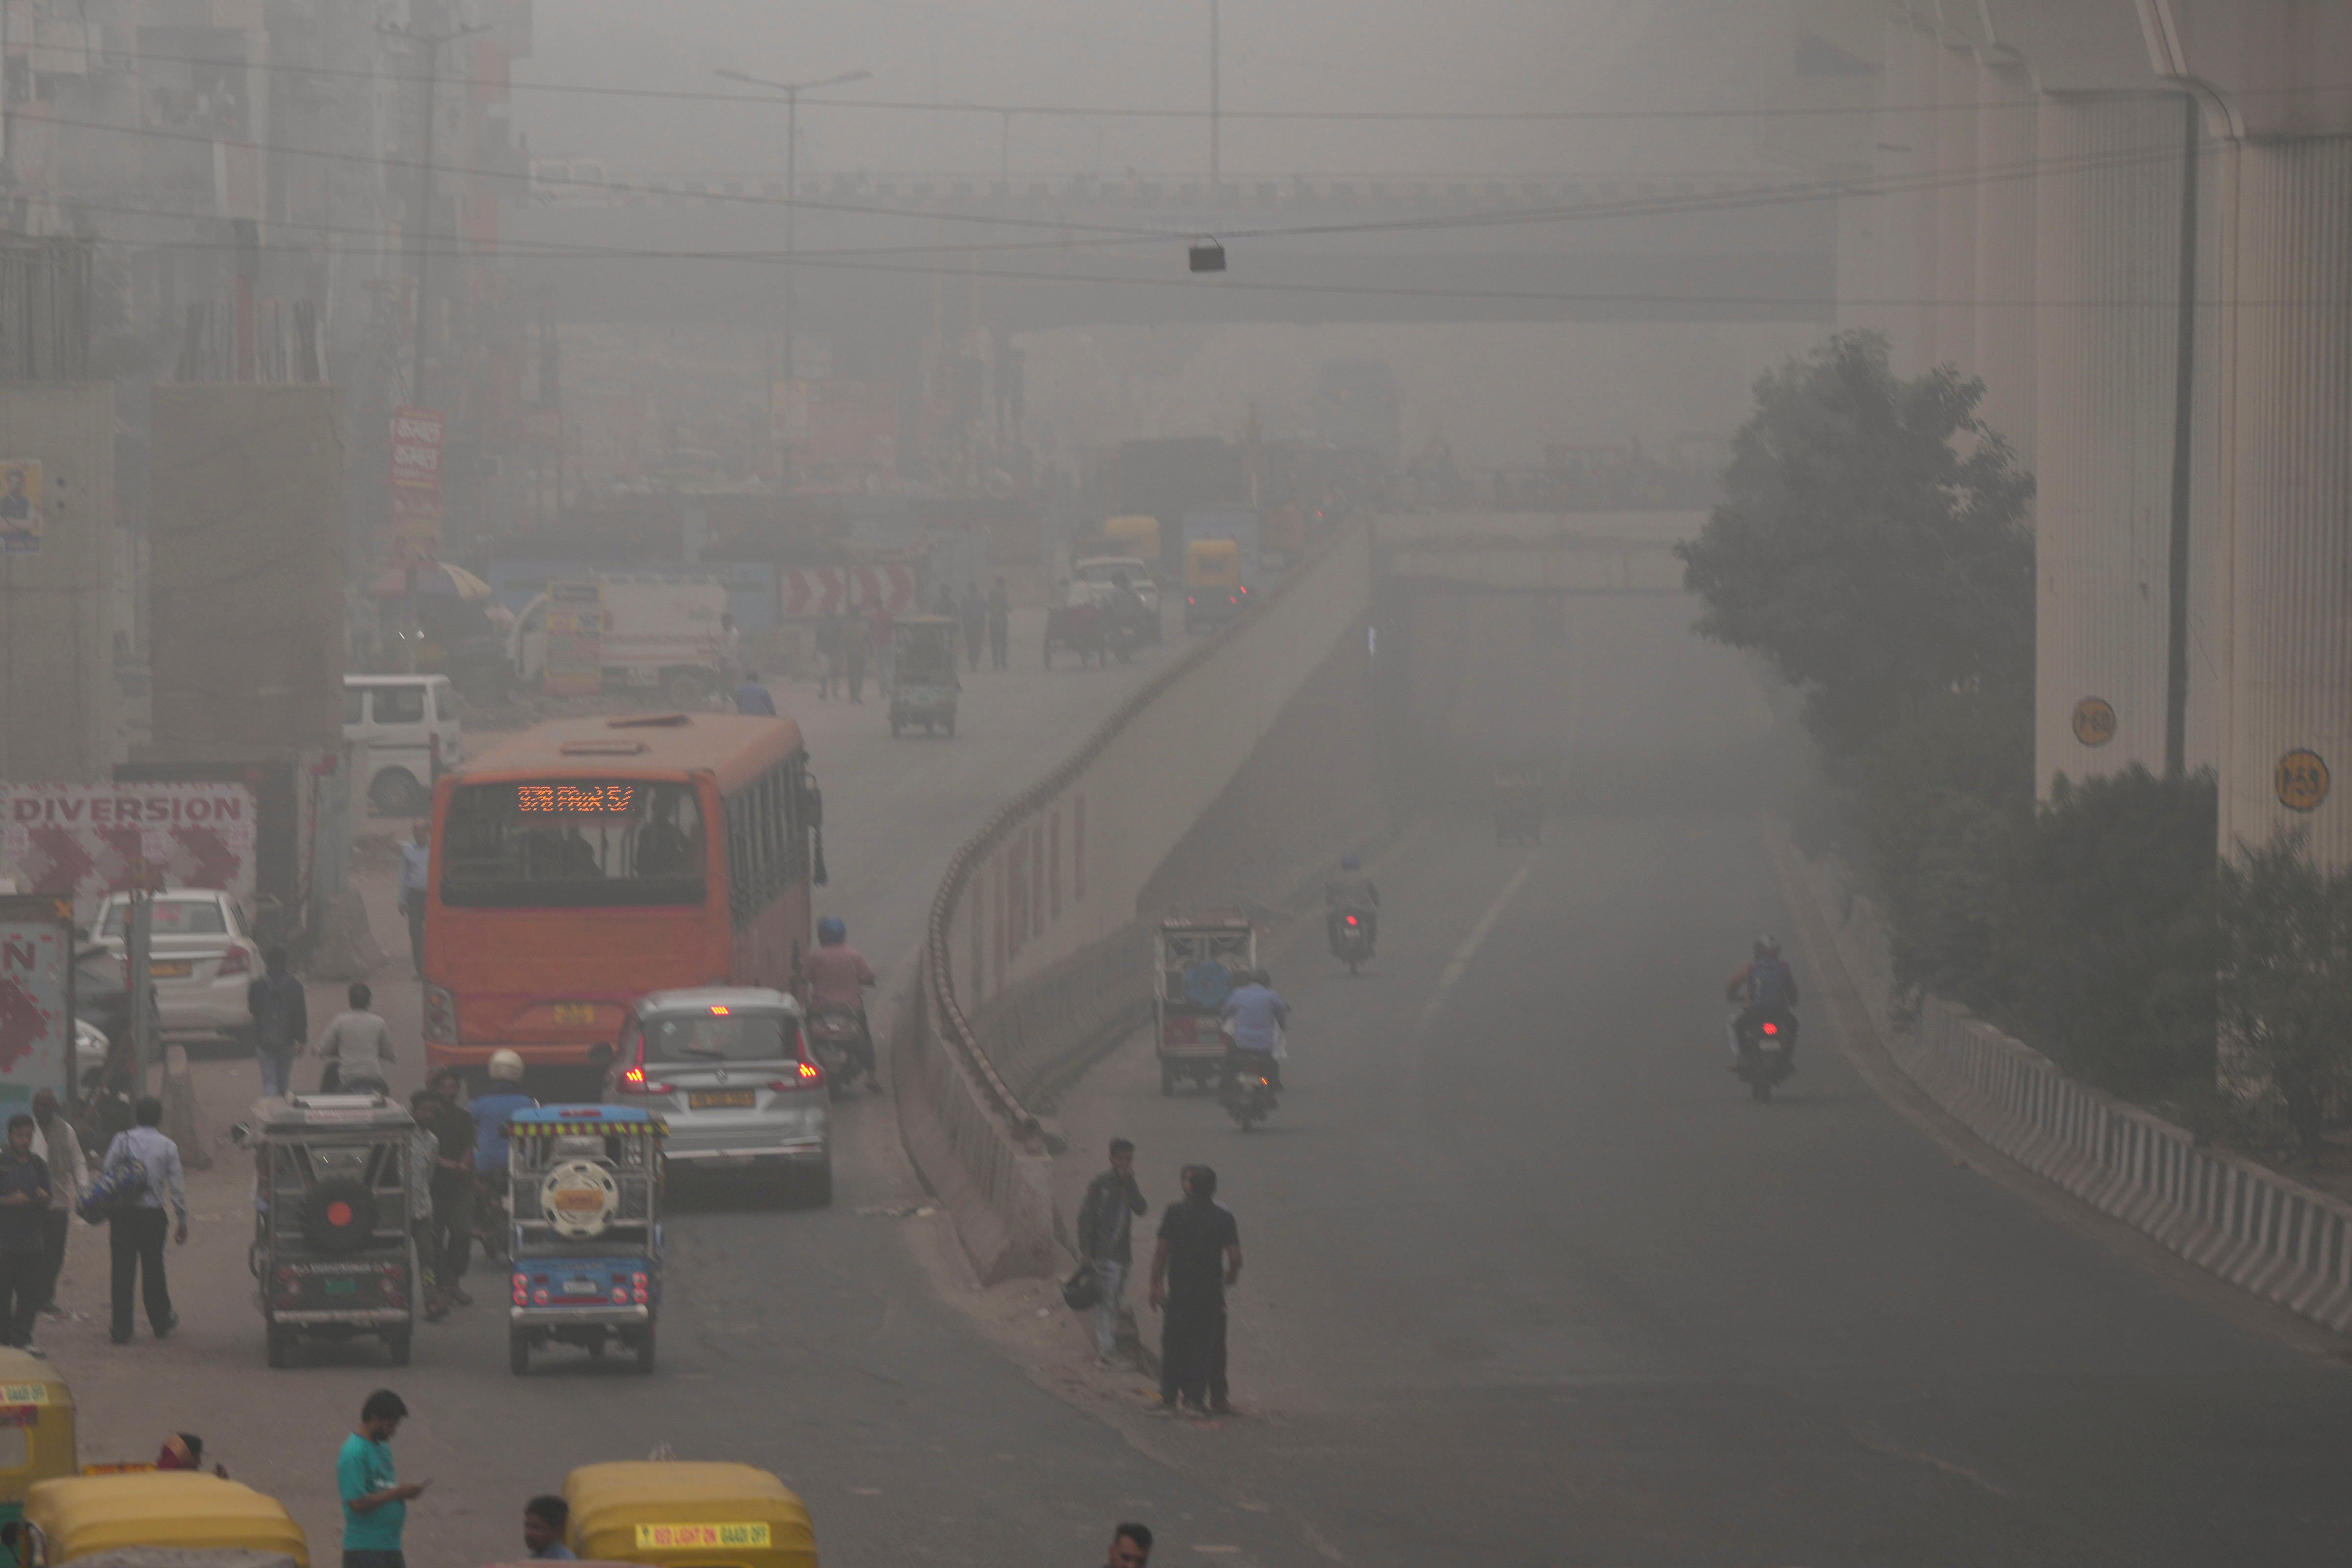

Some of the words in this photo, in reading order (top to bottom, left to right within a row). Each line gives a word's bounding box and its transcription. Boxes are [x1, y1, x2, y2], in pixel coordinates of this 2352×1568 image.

[13, 797, 241, 822] DIVERSION
[654, 1527, 672, 1545] RED
[703, 1526, 716, 1544] ON
[750, 1524, 768, 1543] OFF
